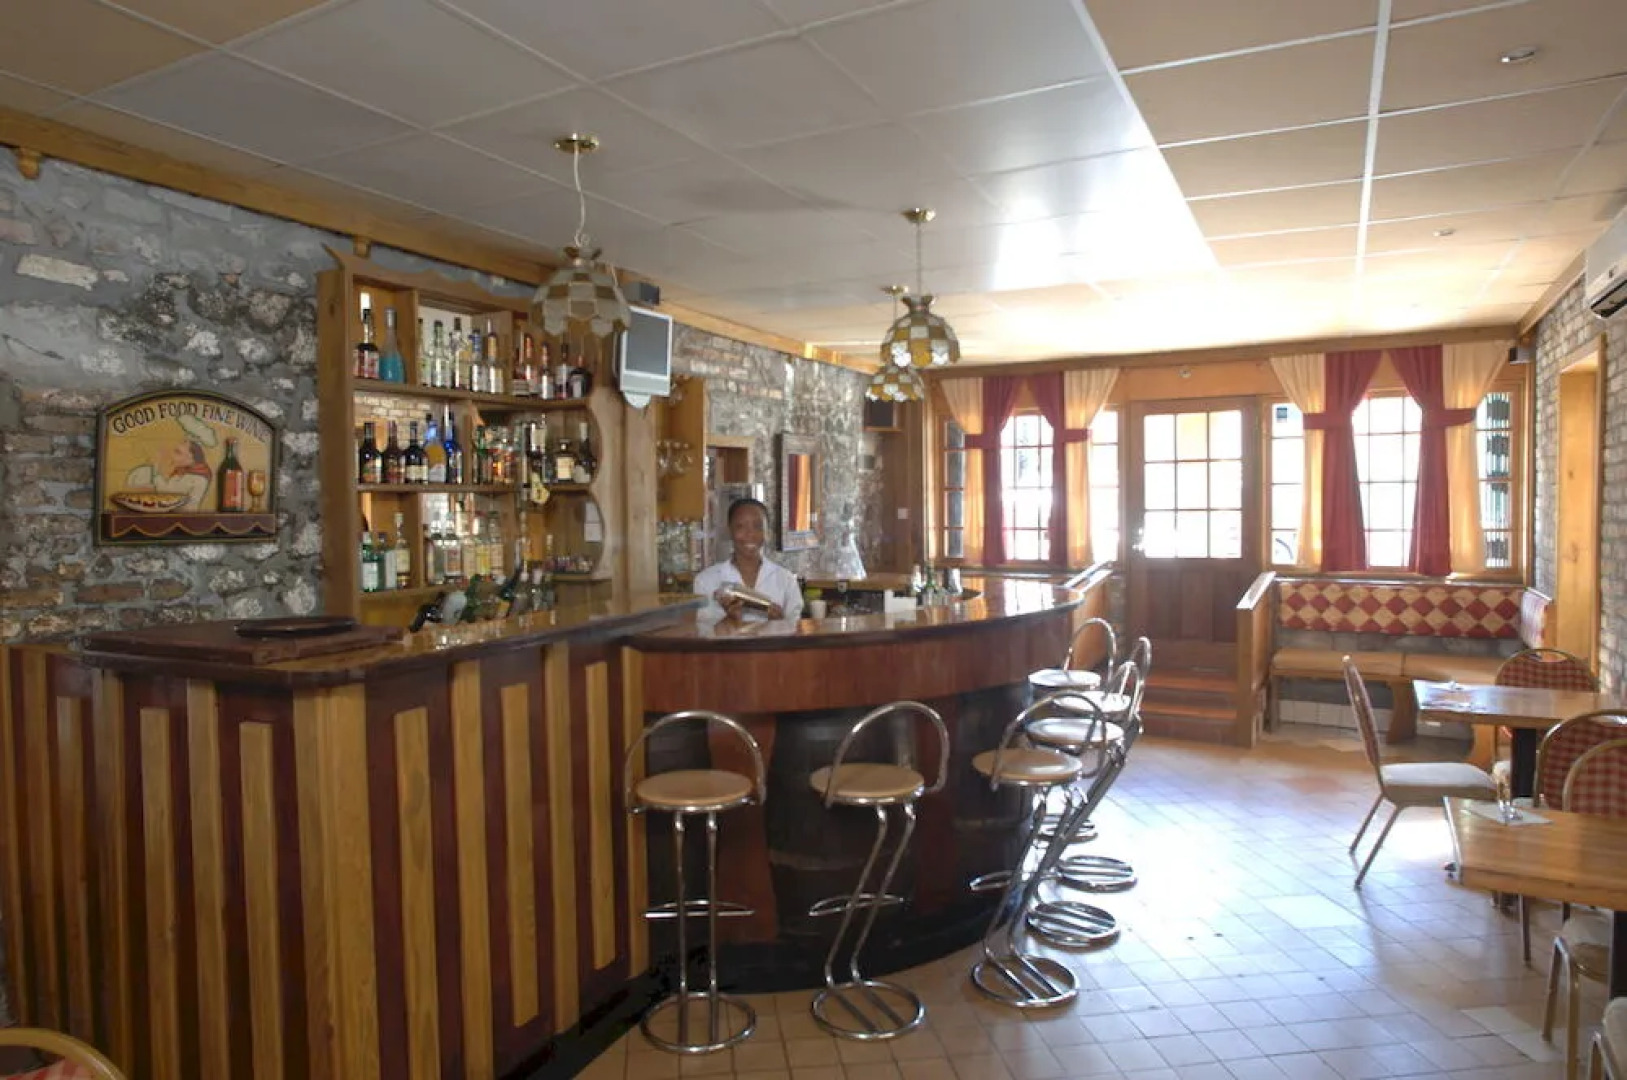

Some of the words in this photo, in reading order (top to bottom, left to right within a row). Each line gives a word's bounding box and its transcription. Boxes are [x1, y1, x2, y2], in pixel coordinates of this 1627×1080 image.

[113, 407, 155, 433] GOOD
[158, 402, 198, 419] FOOD
[202, 404, 233, 424] FINE
